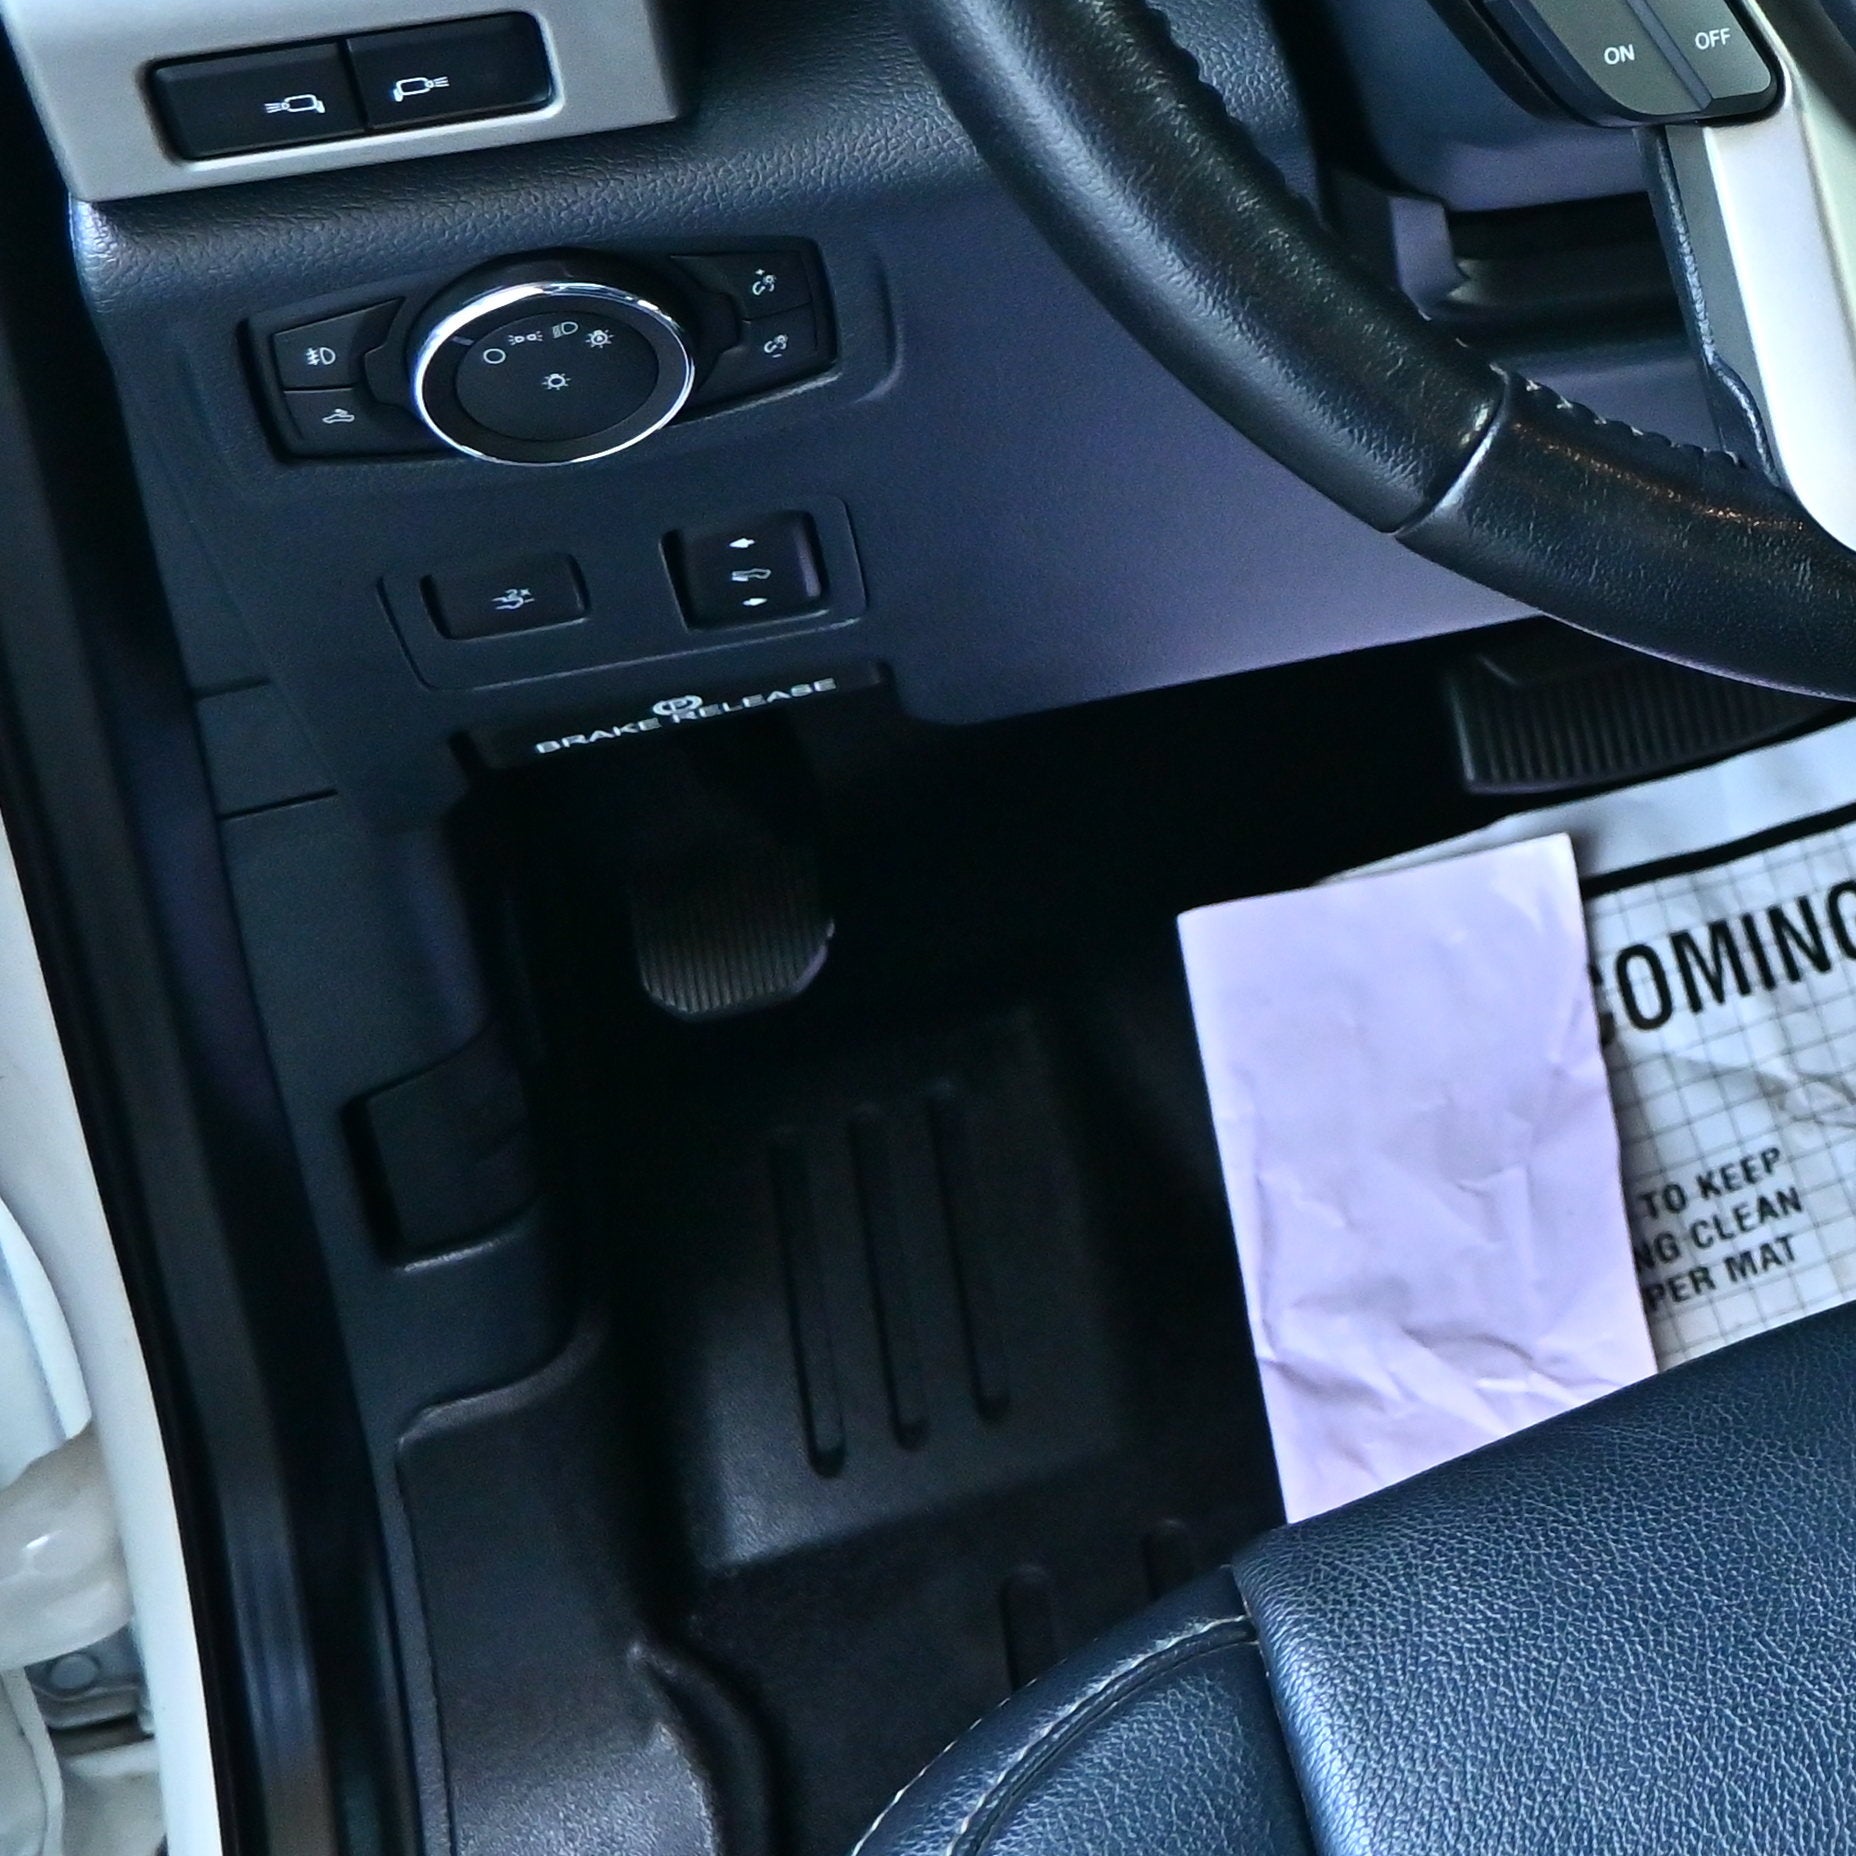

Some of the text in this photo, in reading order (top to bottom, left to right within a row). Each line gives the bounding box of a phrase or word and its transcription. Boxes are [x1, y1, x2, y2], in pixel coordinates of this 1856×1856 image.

[1603, 44, 1636, 66] ON
[1694, 27, 1732, 51] OFF
[535, 677, 838, 754] BRAKE RELEASE
[1639, 1146, 1781, 1221] TO KEEP
[1688, 1186, 1804, 1250] CLEAN
[1643, 1232, 1797, 1313] PER MAT
